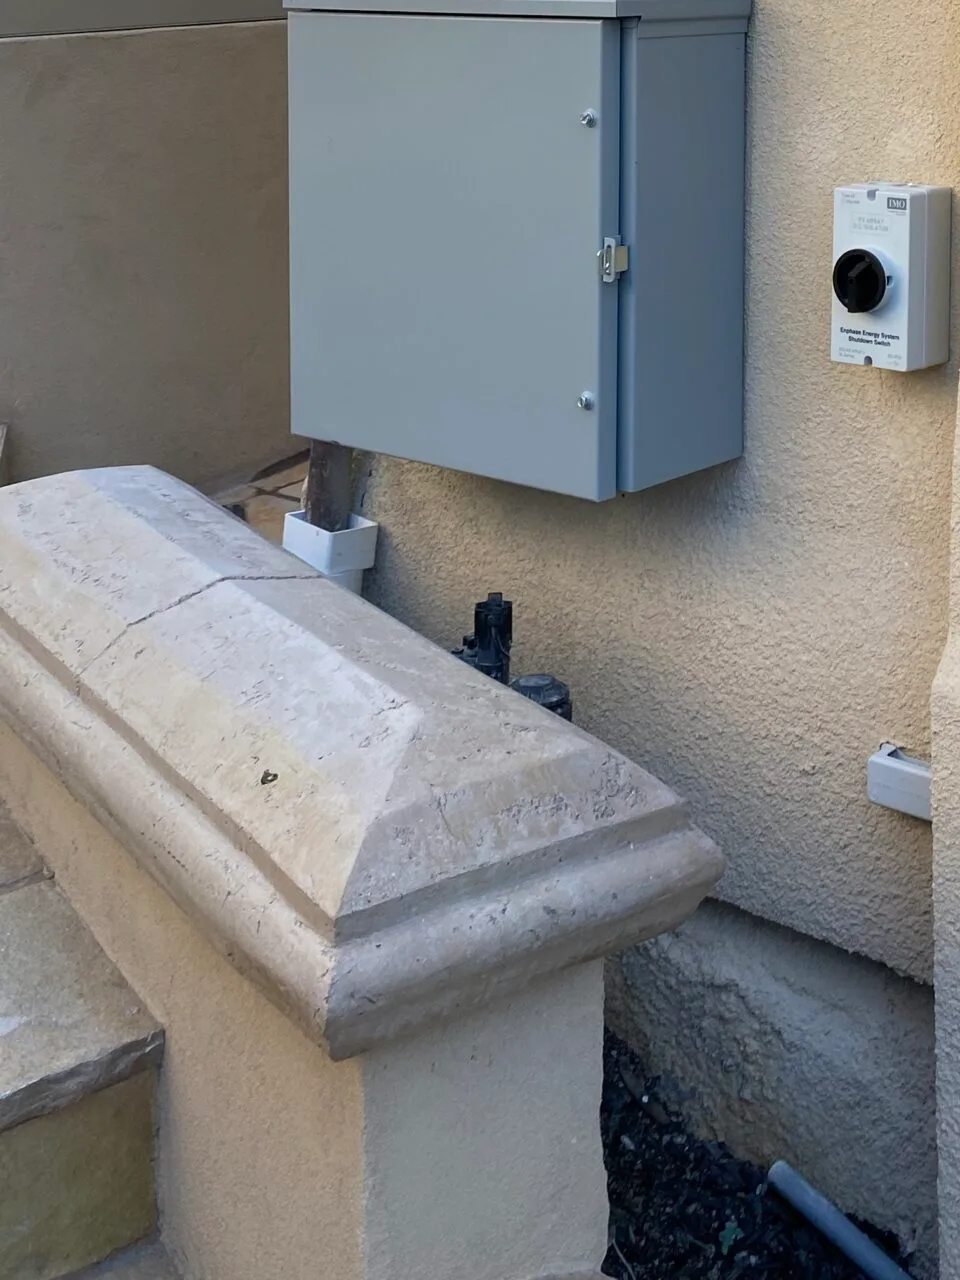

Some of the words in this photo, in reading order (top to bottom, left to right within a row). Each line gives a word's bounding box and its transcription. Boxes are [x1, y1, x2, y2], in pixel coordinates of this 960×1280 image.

[888, 199, 906, 209] IMO
[840, 326, 861, 335] Enphase
[862, 330, 880, 339] Energy
[881, 332, 900, 340] System
[848, 335, 873, 344] Shutdown
[874, 339, 891, 347] Switch
